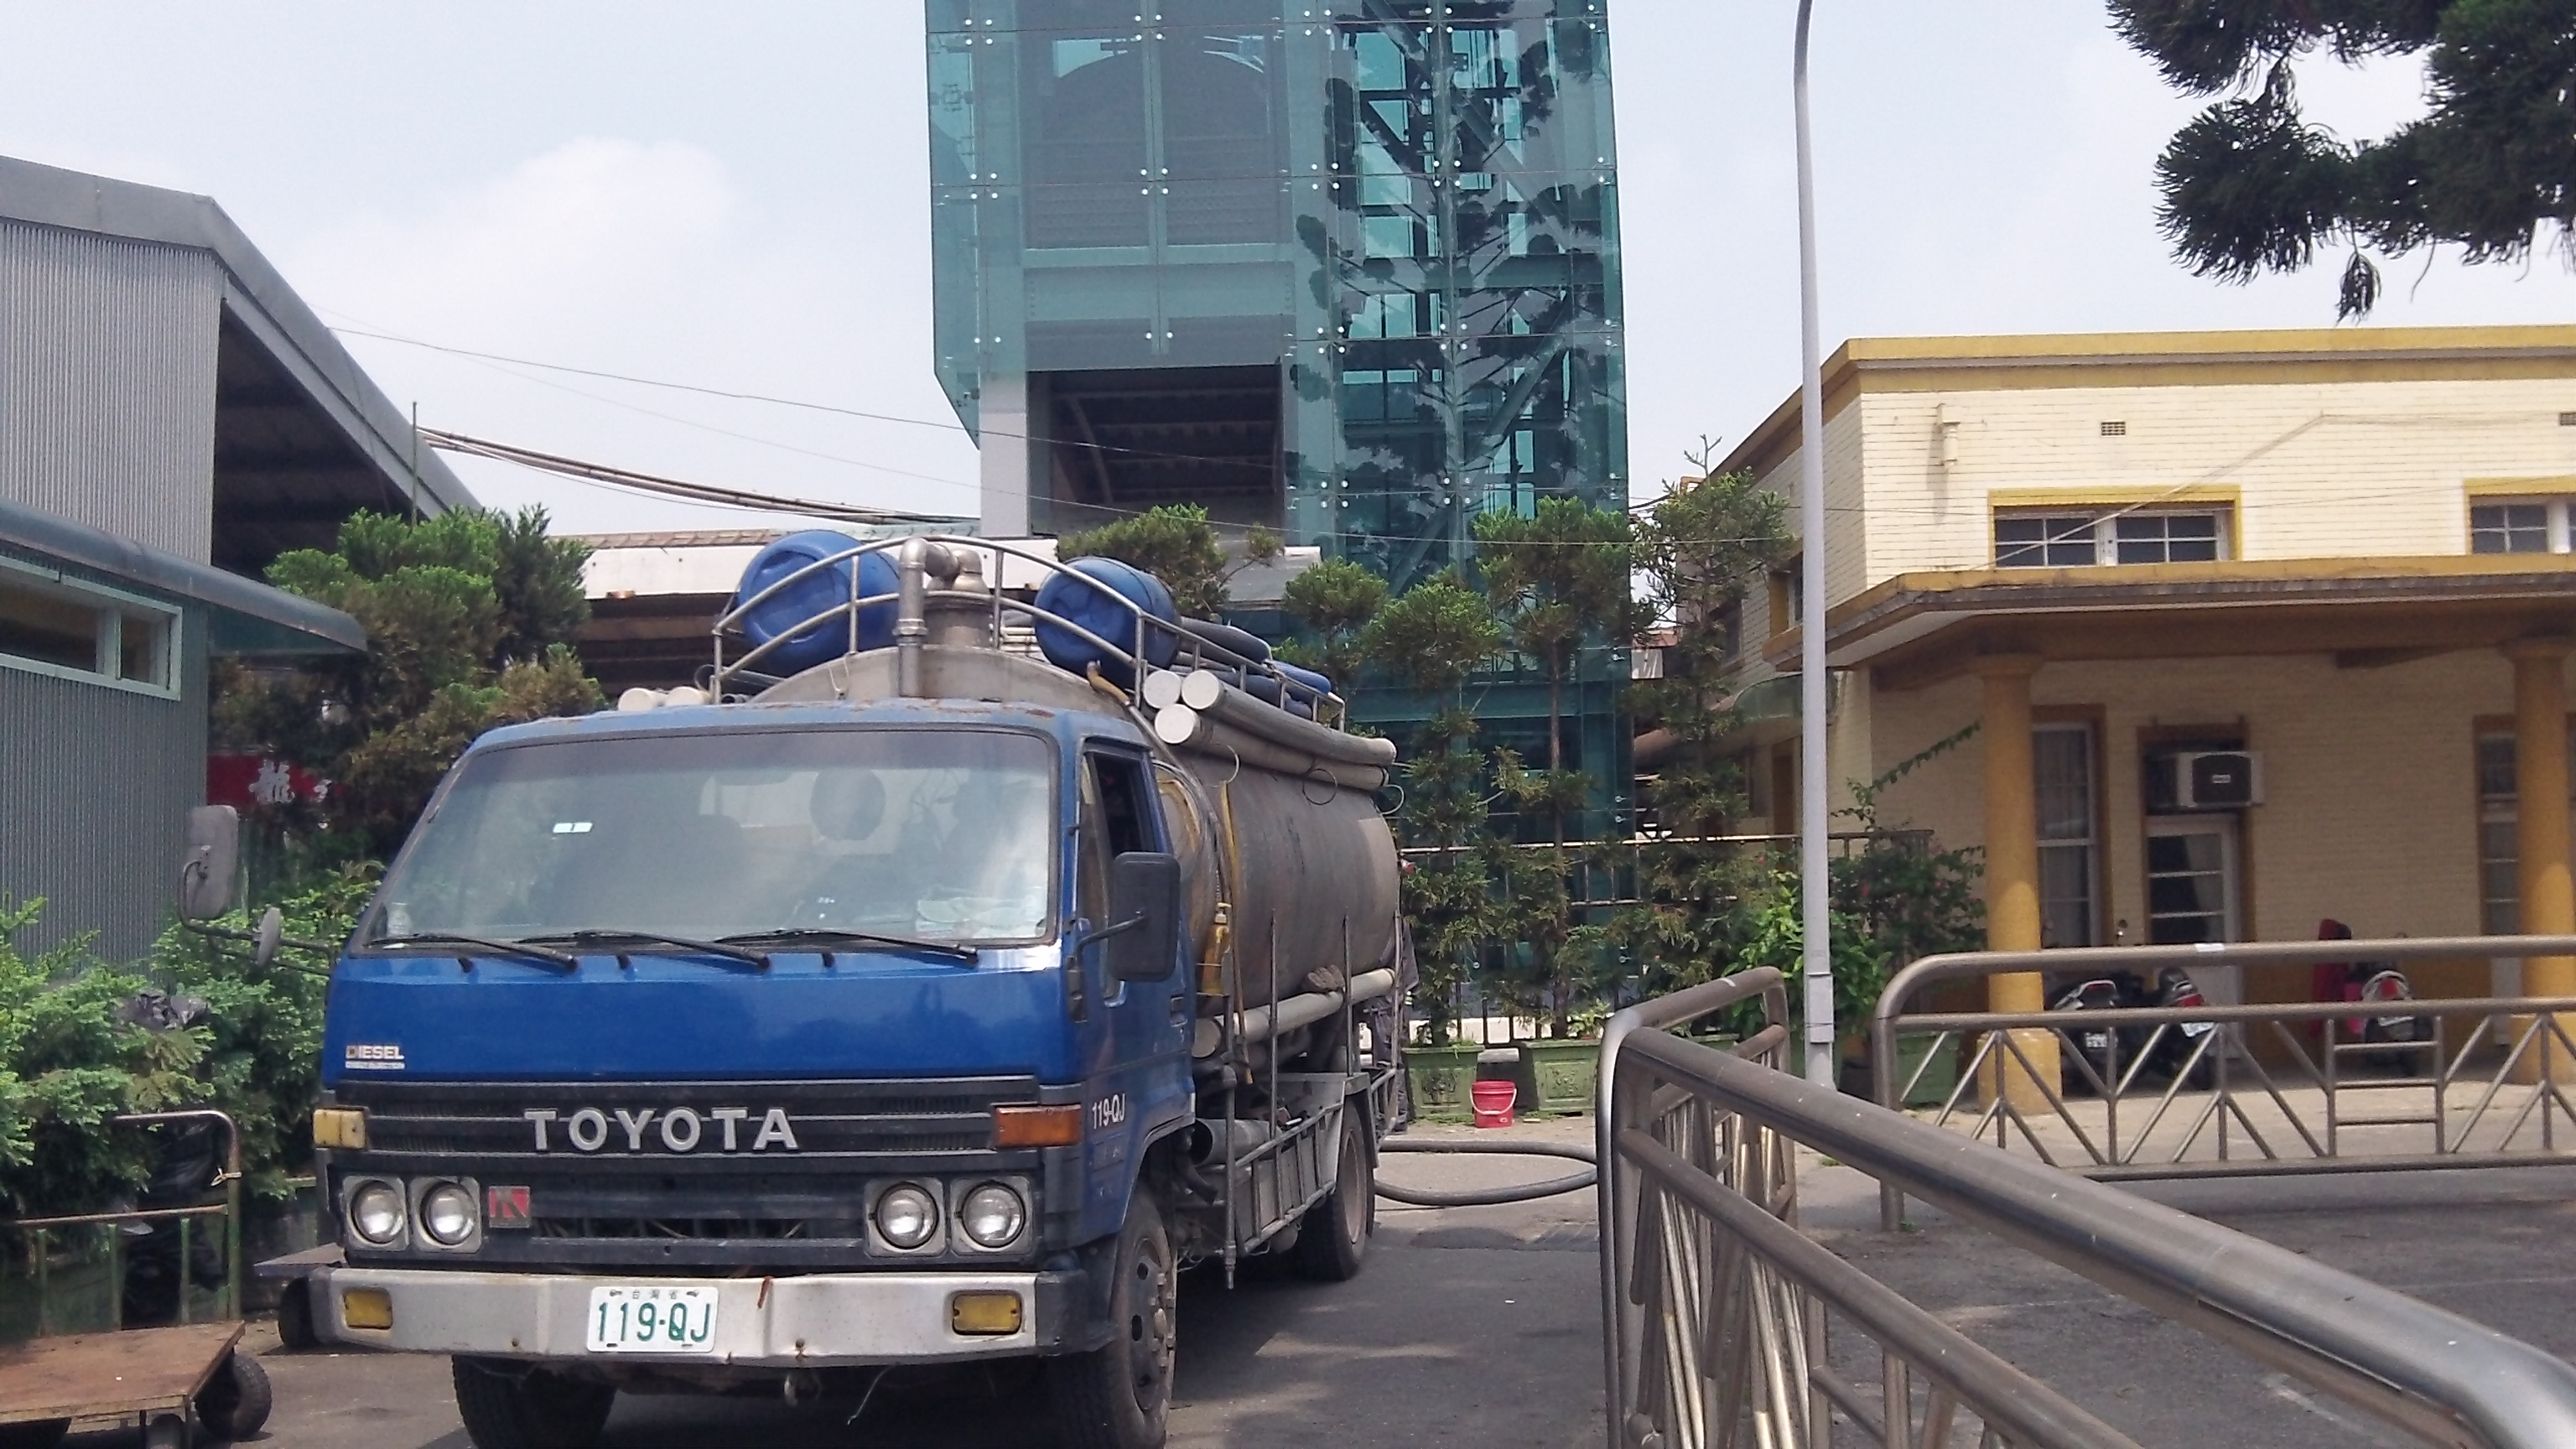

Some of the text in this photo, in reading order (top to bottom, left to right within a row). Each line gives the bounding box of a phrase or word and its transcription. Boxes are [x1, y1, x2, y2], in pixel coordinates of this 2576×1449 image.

[345, 1045, 405, 1060] DIESEL
[1093, 1093, 1124, 1129] 119-QJ
[524, 1108, 798, 1151] TOYOTA
